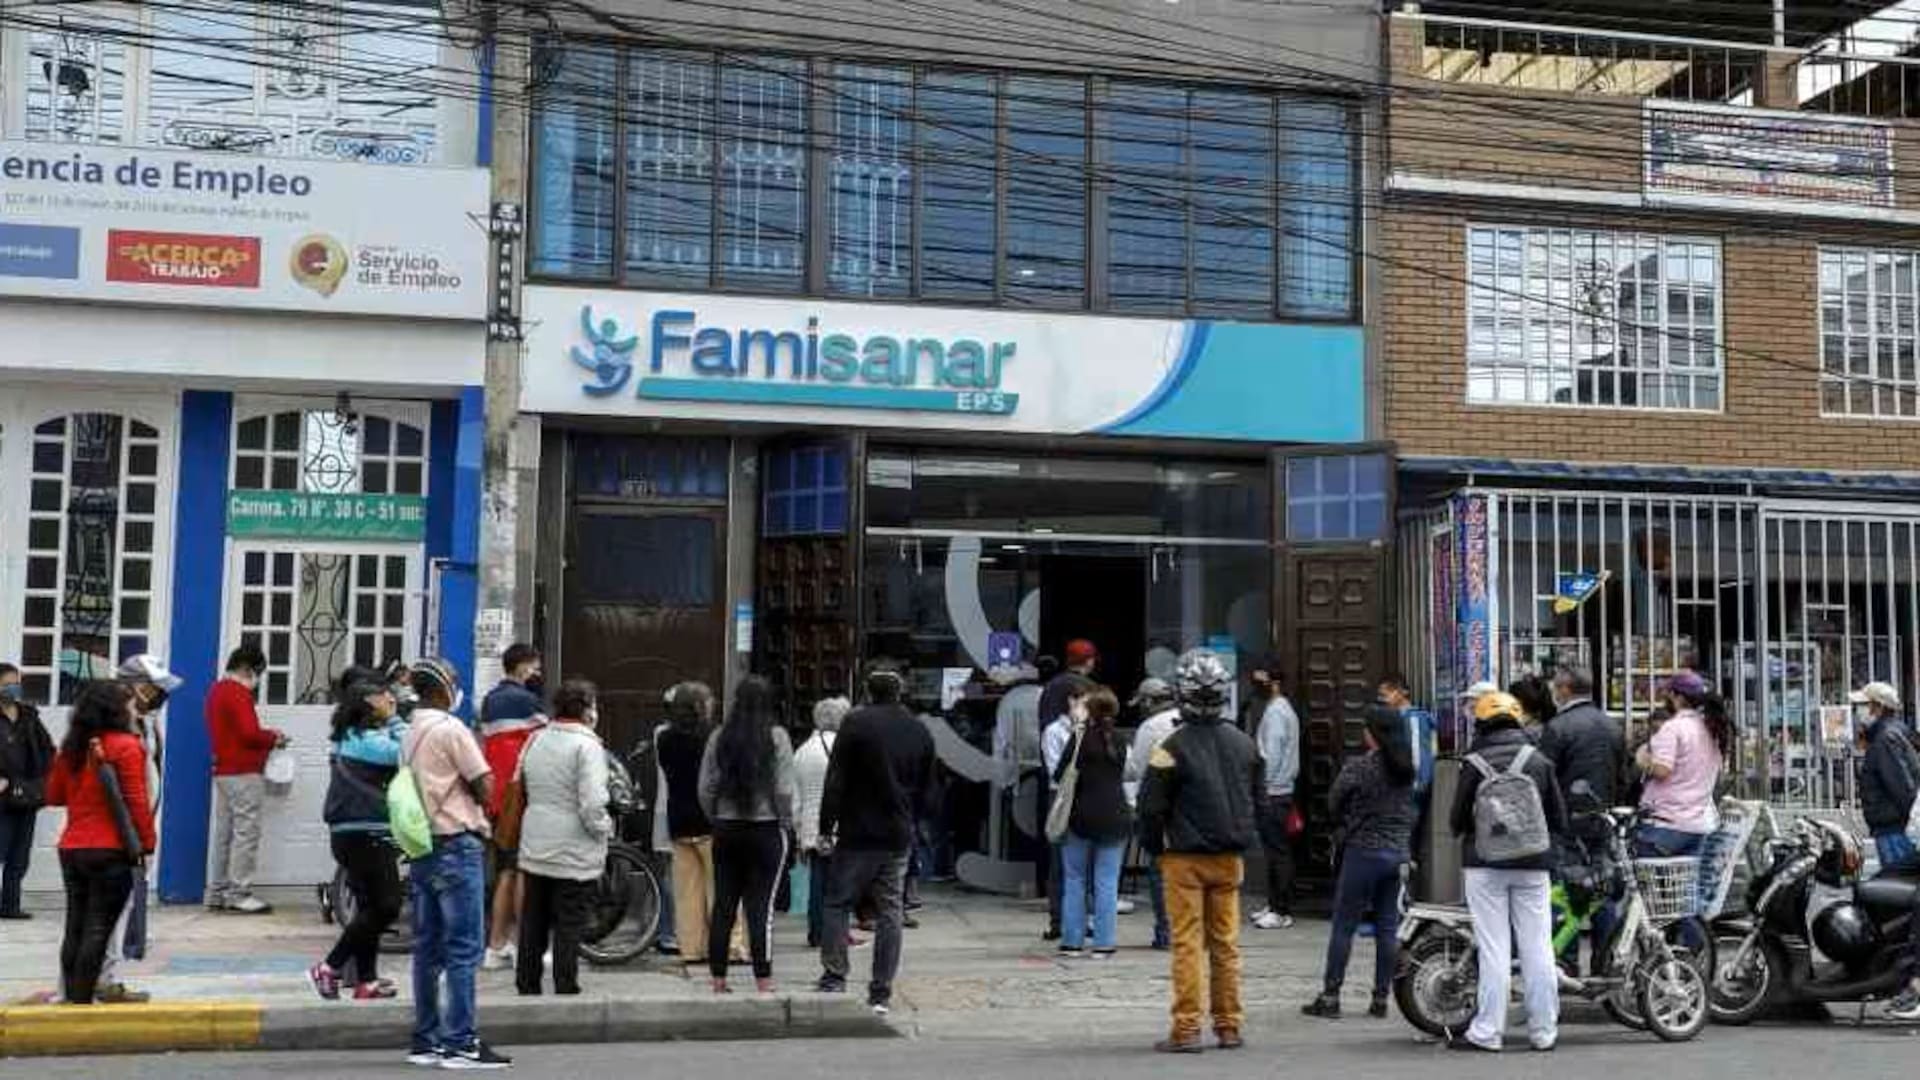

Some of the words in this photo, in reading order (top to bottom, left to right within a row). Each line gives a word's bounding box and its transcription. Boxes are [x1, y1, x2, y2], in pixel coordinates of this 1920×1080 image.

[2, 152, 104, 184] encia
[115, 157, 161, 188] de
[173, 161, 312, 199] Empleo
[132, 242, 239, 267] ACERCA
[359, 250, 440, 271] Servicio
[151, 261, 221, 279] TRABAJO
[357, 269, 382, 284] de
[388, 269, 462, 291] Empleo
[651, 310, 1017, 389] Famisanar
[956, 391, 1005, 412] EPS
